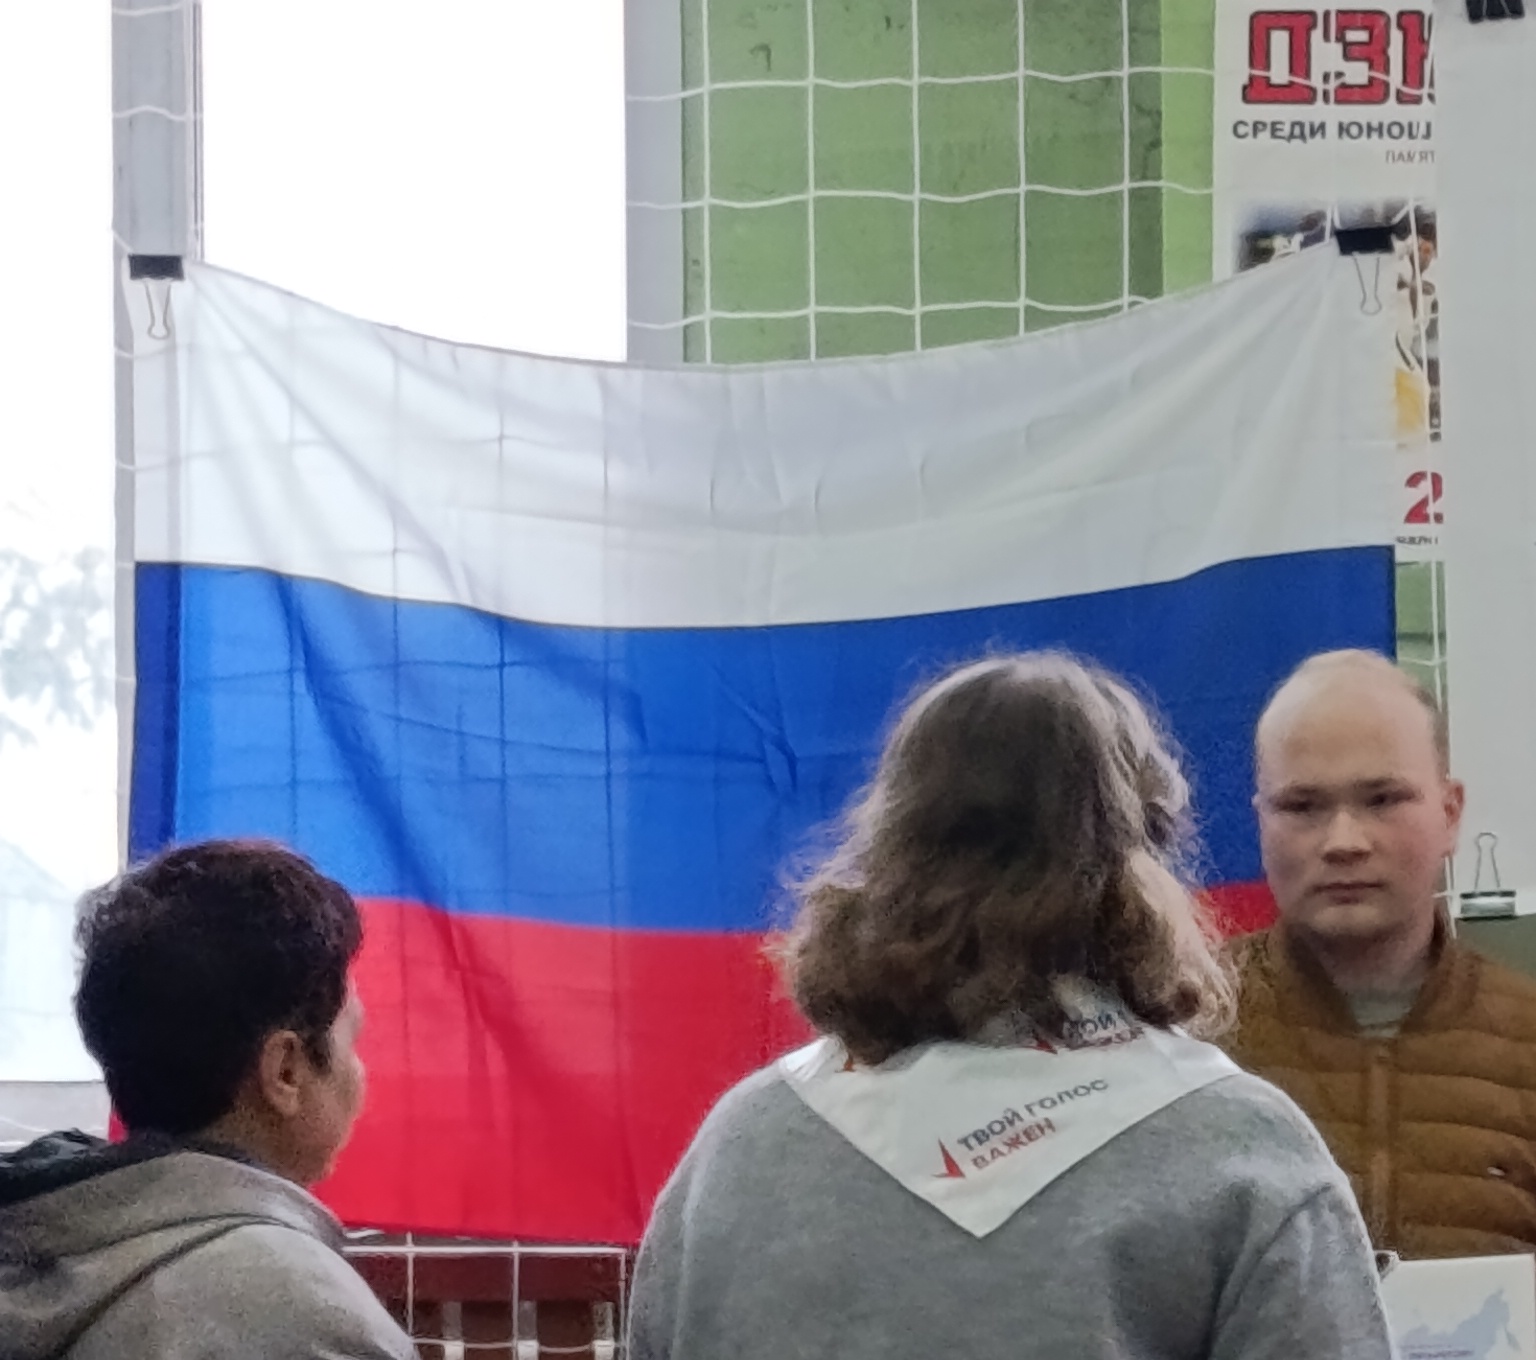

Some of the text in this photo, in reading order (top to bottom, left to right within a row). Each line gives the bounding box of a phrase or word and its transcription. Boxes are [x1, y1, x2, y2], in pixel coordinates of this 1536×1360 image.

[1232, 119, 1327, 143] СРЕДИ
[957, 1079, 1109, 1152] ТВОЙ ГОЛОС
[971, 1117, 1056, 1168] ВАЖЕН
